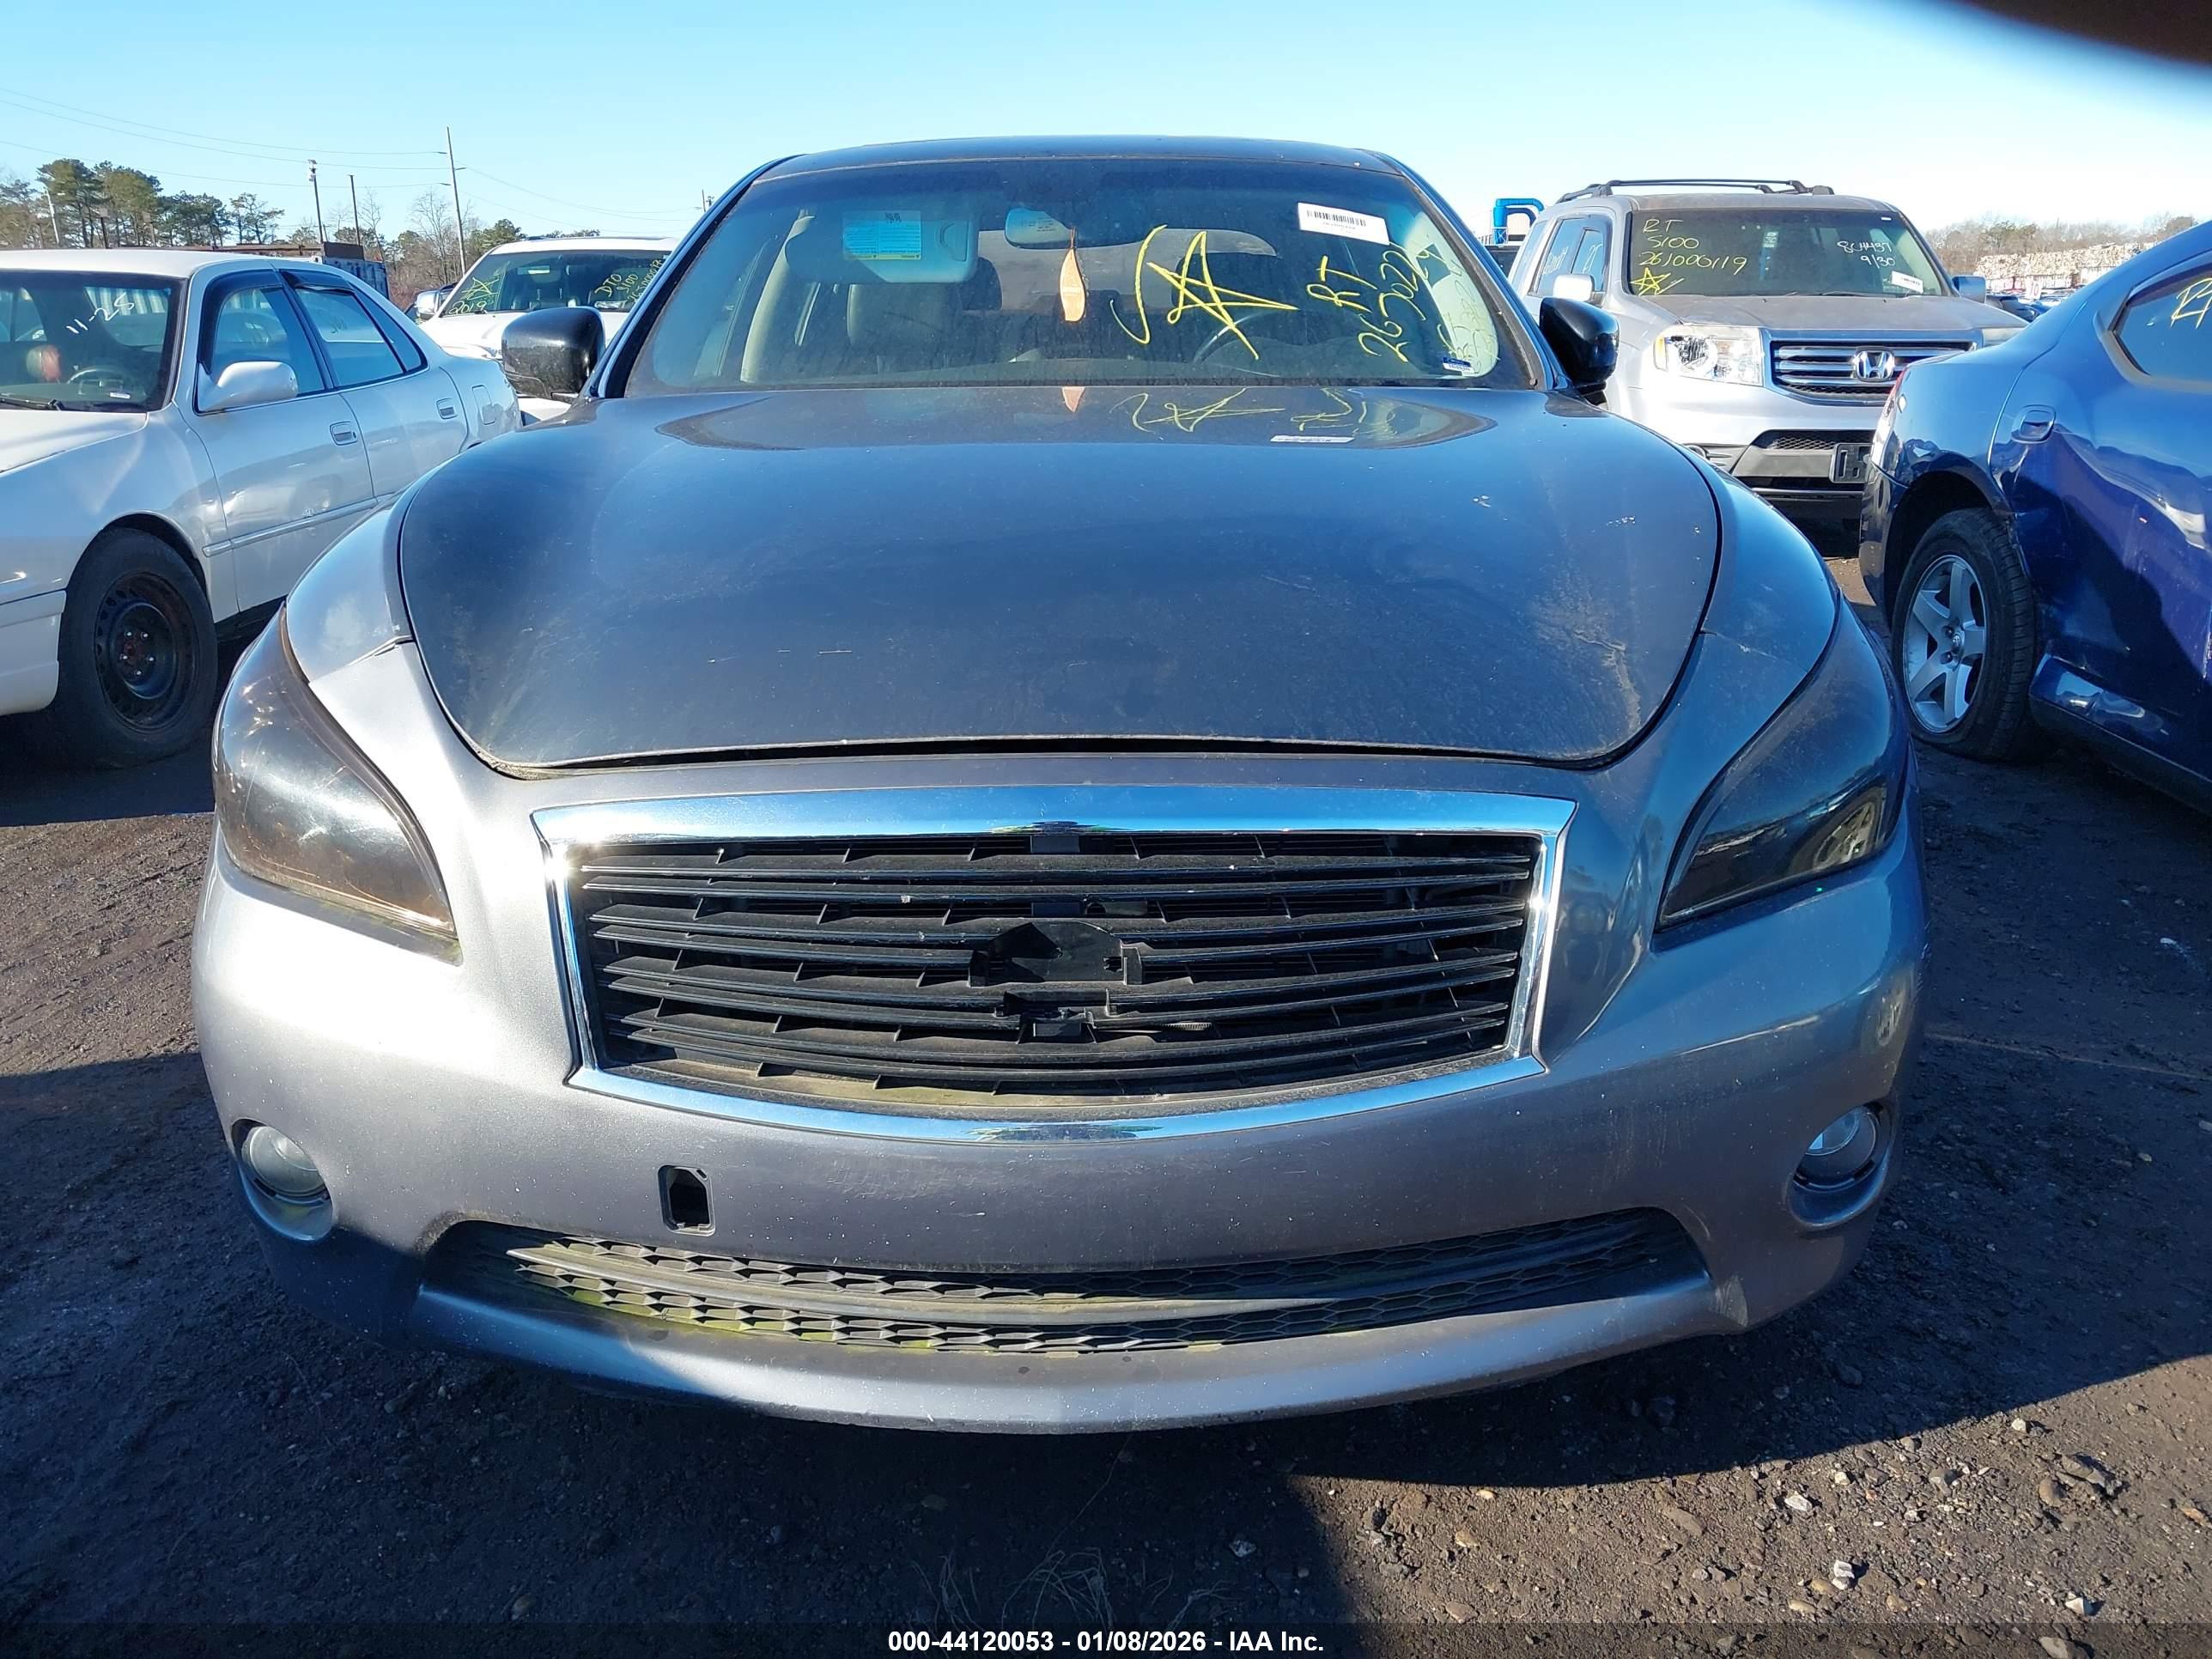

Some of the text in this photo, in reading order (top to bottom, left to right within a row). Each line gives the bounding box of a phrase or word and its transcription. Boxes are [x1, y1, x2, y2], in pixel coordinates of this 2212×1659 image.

[1643, 219, 1684, 233] RT
[1860, 254, 1896, 269] 9/30
[1305, 255, 1378, 313] RT
